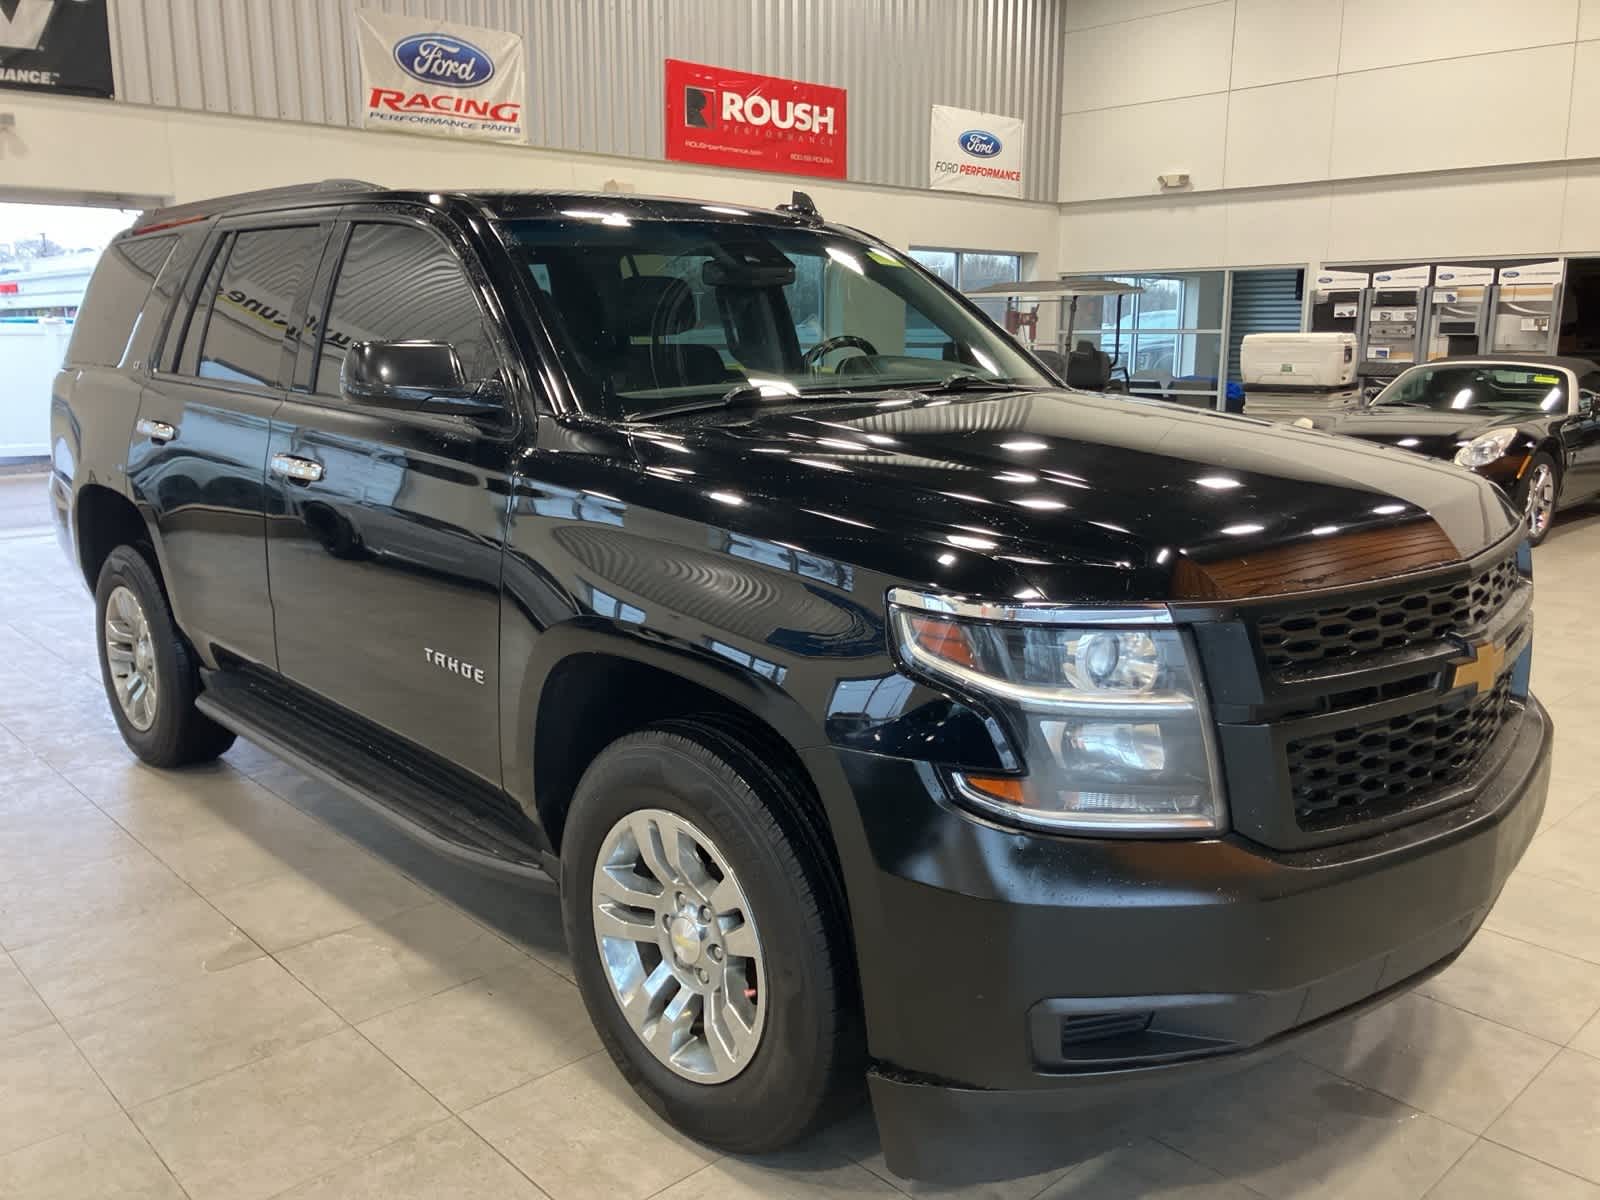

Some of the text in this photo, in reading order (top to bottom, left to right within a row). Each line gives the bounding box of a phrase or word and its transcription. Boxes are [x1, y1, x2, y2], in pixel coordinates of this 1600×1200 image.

[413, 40, 477, 81] Ford
[369, 87, 521, 123] RACING
[369, 111, 521, 134] PERFORMANCE PARTS
[721, 90, 836, 135] ROUSH
[966, 133, 994, 154] Ford
[935, 161, 1021, 181] FORD PERFORMANCE
[423, 647, 485, 685] TAHOE
